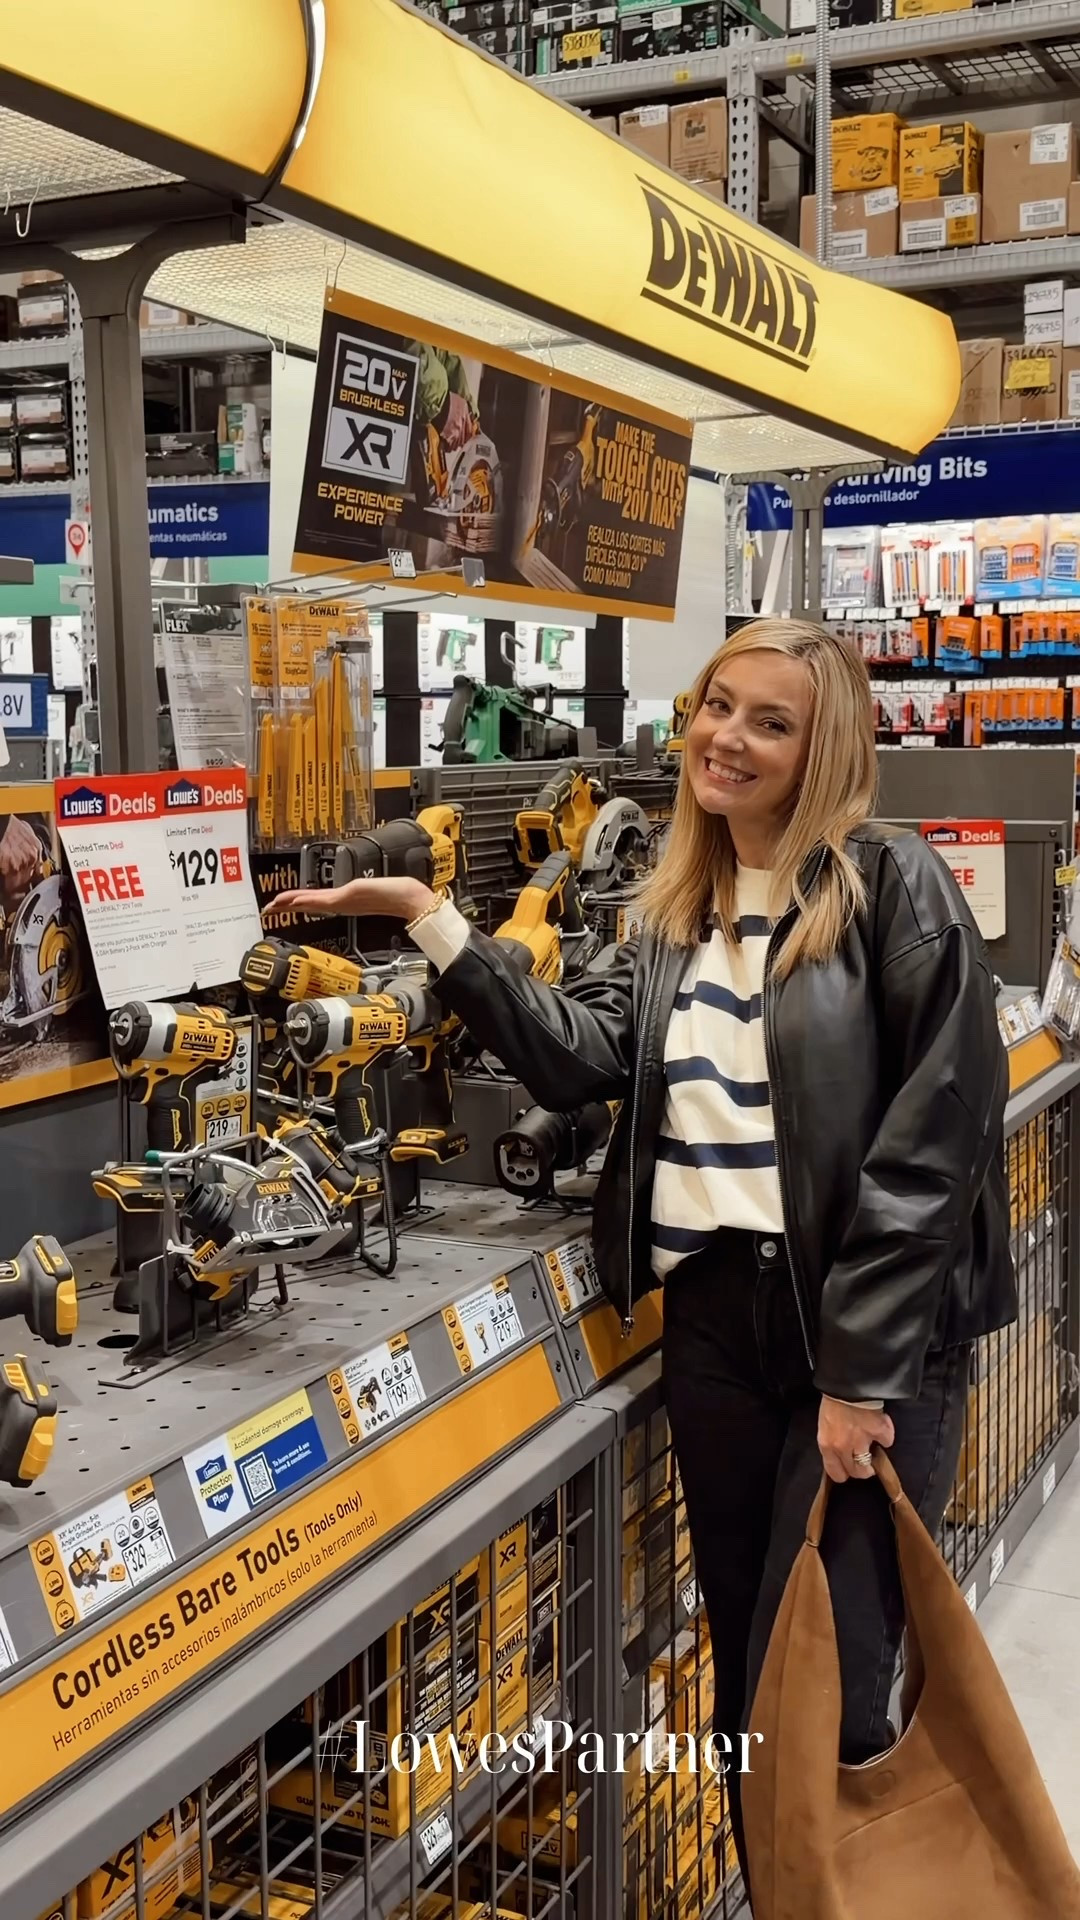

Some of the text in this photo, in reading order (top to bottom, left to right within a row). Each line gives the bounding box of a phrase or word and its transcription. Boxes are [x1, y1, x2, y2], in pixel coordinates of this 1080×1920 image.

[640, 185, 820, 359] DEWALT
[339, 388, 406, 417] BRUSHLESS
[614, 421, 656, 454] MAKE THE
[596, 436, 686, 499] TOUGH CUTS
[939, 456, 988, 481] Bits
[317, 481, 404, 513] EXPERIENCE
[601, 478, 624, 504] WITH
[621, 487, 650, 522] 20V
[833, 488, 920, 506] destornillador
[333, 503, 384, 527] POWER
[175, 530, 228, 543] neumáticas
[587, 524, 615, 544] REALIZA
[615, 530, 629, 549] LOS
[629, 535, 652, 554] CORTES
[617, 551, 631, 568] CON
[582, 565, 604, 584] COMO
[309, 605, 340, 617] DEWALT
[165, 618, 190, 633] FLEX
[0, 694, 23, 717] 8V
[63, 791, 157, 817] LOWE'S Deals
[167, 783, 244, 807] LOWE'S Deals
[166, 824, 214, 837] Limited Time Deal
[961, 829, 1001, 843] Deals
[68, 841, 124, 854] Limited Time Deal
[222, 854, 238, 864] Save
[73, 859, 90, 868] Get 2
[169, 847, 219, 888] $129
[76, 864, 145, 905] FREE
[258, 863, 298, 893] with
[33, 914, 44, 926] XR
[182, 1031, 219, 1045] DEWALT
[359, 1021, 392, 1032] DEWALT
[256, 1180, 291, 1196] DEWALT
[234, 1429, 261, 1451] Accidental
[261, 1417, 282, 1435] damage
[282, 1406, 305, 1423] coverage
[272, 1459, 278, 1468] To
[288, 1448, 299, 1458] more
[200, 1473, 233, 1498] Protection
[211, 1491, 230, 1507] Plan
[61, 1521, 102, 1548] Angle Grinder Kit
[117, 1529, 126, 1538] 20
[499, 1541, 517, 1568] XR
[52, 1490, 363, 1710] Cordless Bare Tools (Tools Only)
[52, 1510, 379, 1752] Herramientas sin accesorios inalámbricos (solo la herramienta)
[496, 1628, 524, 1662] DEWALT
[497, 1662, 513, 1690] XR
